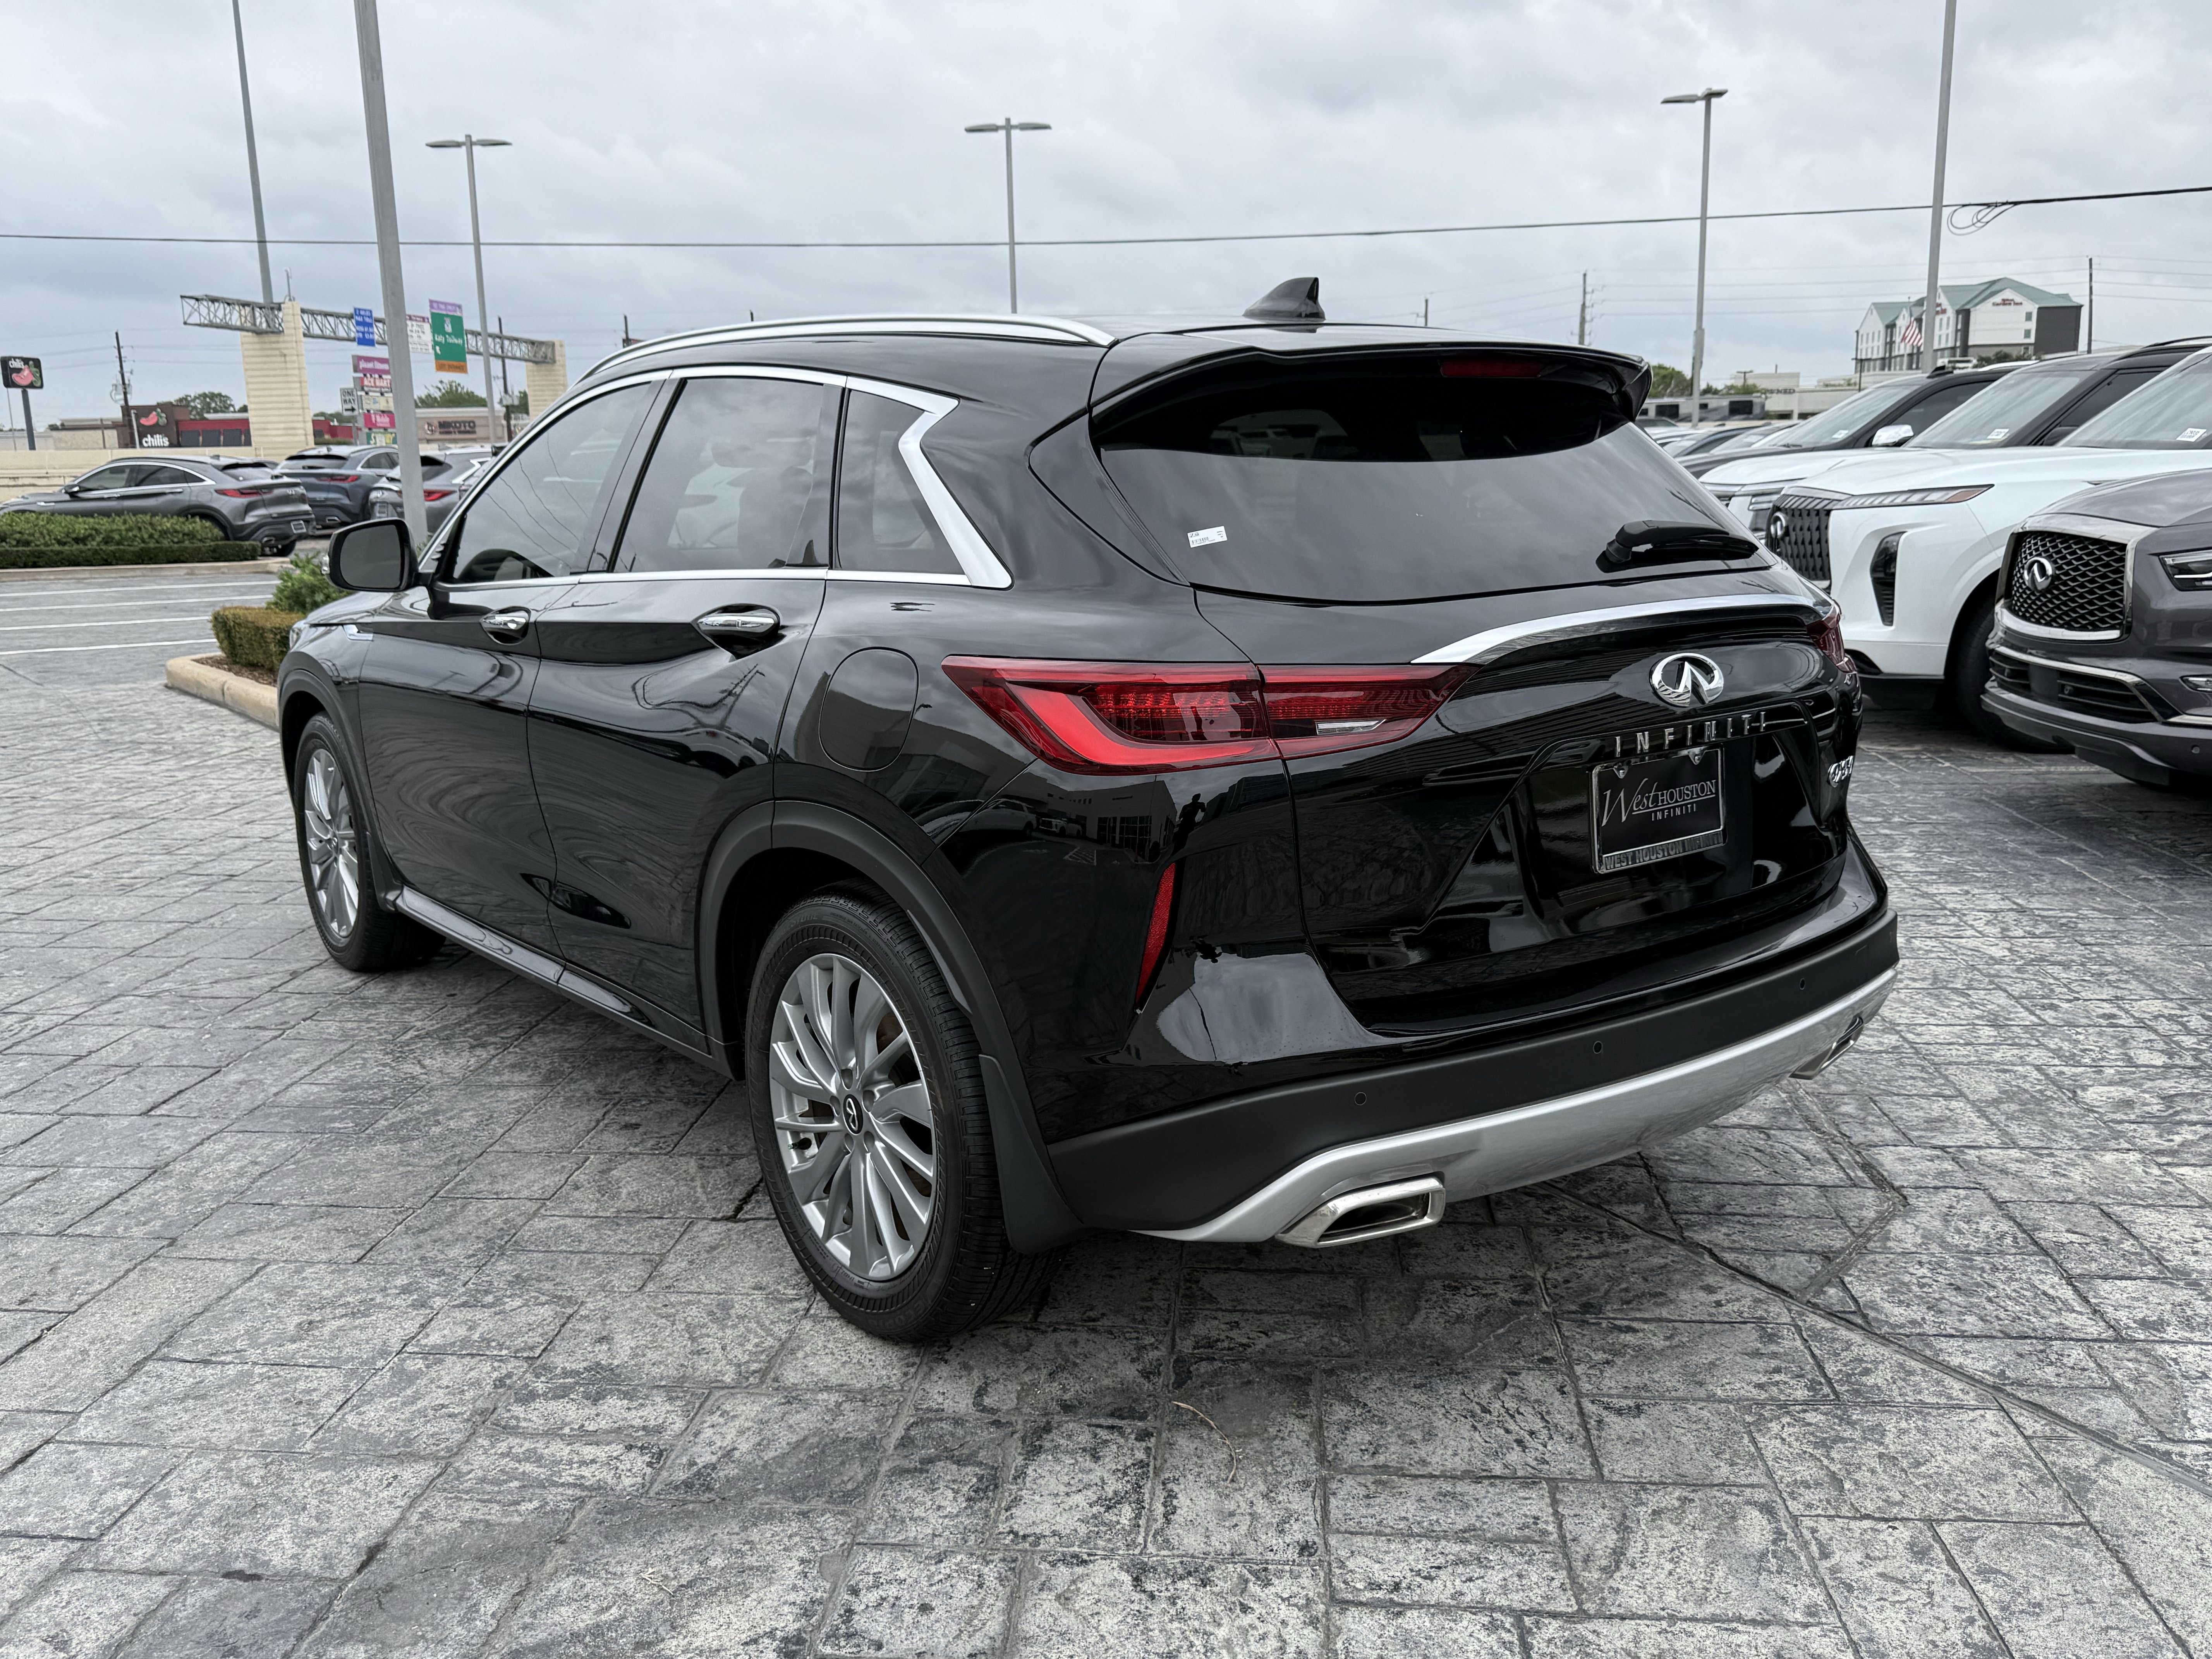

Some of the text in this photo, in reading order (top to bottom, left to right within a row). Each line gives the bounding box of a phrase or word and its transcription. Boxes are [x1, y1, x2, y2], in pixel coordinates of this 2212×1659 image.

[438, 420, 476, 429] MIKOTO
[1615, 712, 1766, 757] INFINITI
[1601, 778, 1717, 827] West HOUSTON
[1652, 803, 1697, 821] INFINITI
[1604, 831, 1723, 870] WEST HOUSTON INFINITI
